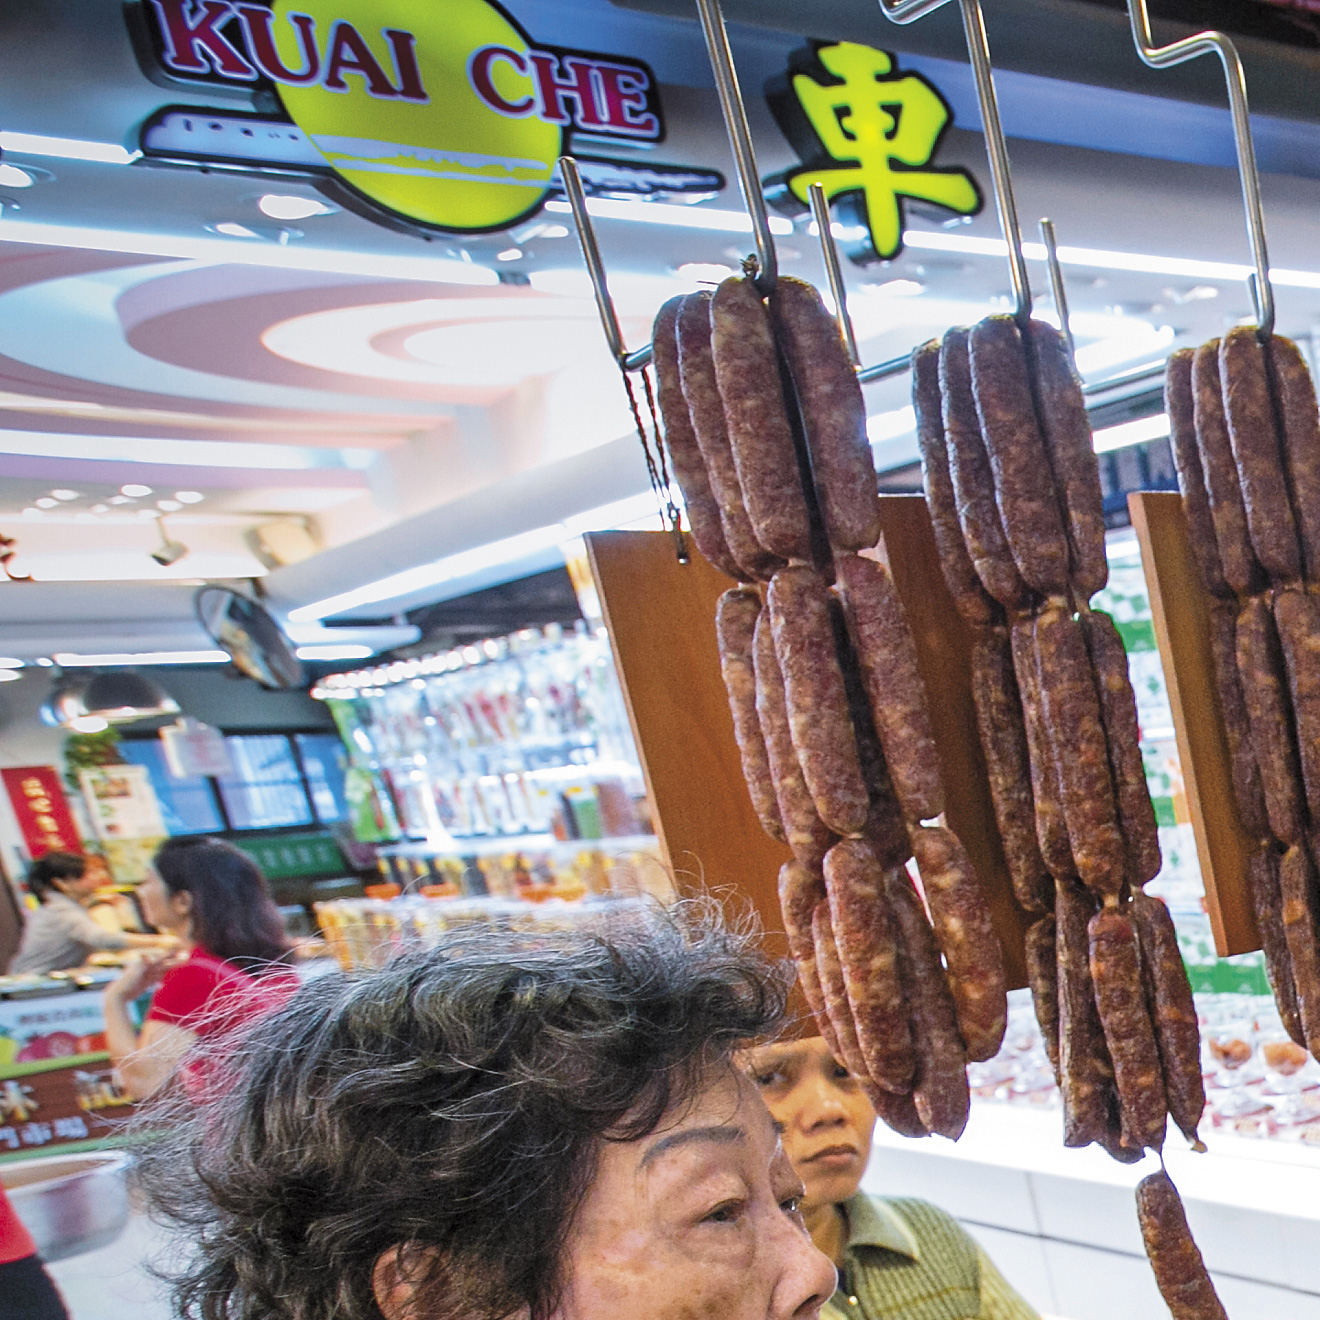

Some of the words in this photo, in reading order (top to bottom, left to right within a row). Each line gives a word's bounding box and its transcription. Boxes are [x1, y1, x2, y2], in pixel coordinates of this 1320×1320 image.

[158, 0, 431, 104] KUAI
[469, 45, 659, 136] CHE
[790, 41, 982, 260] 車
